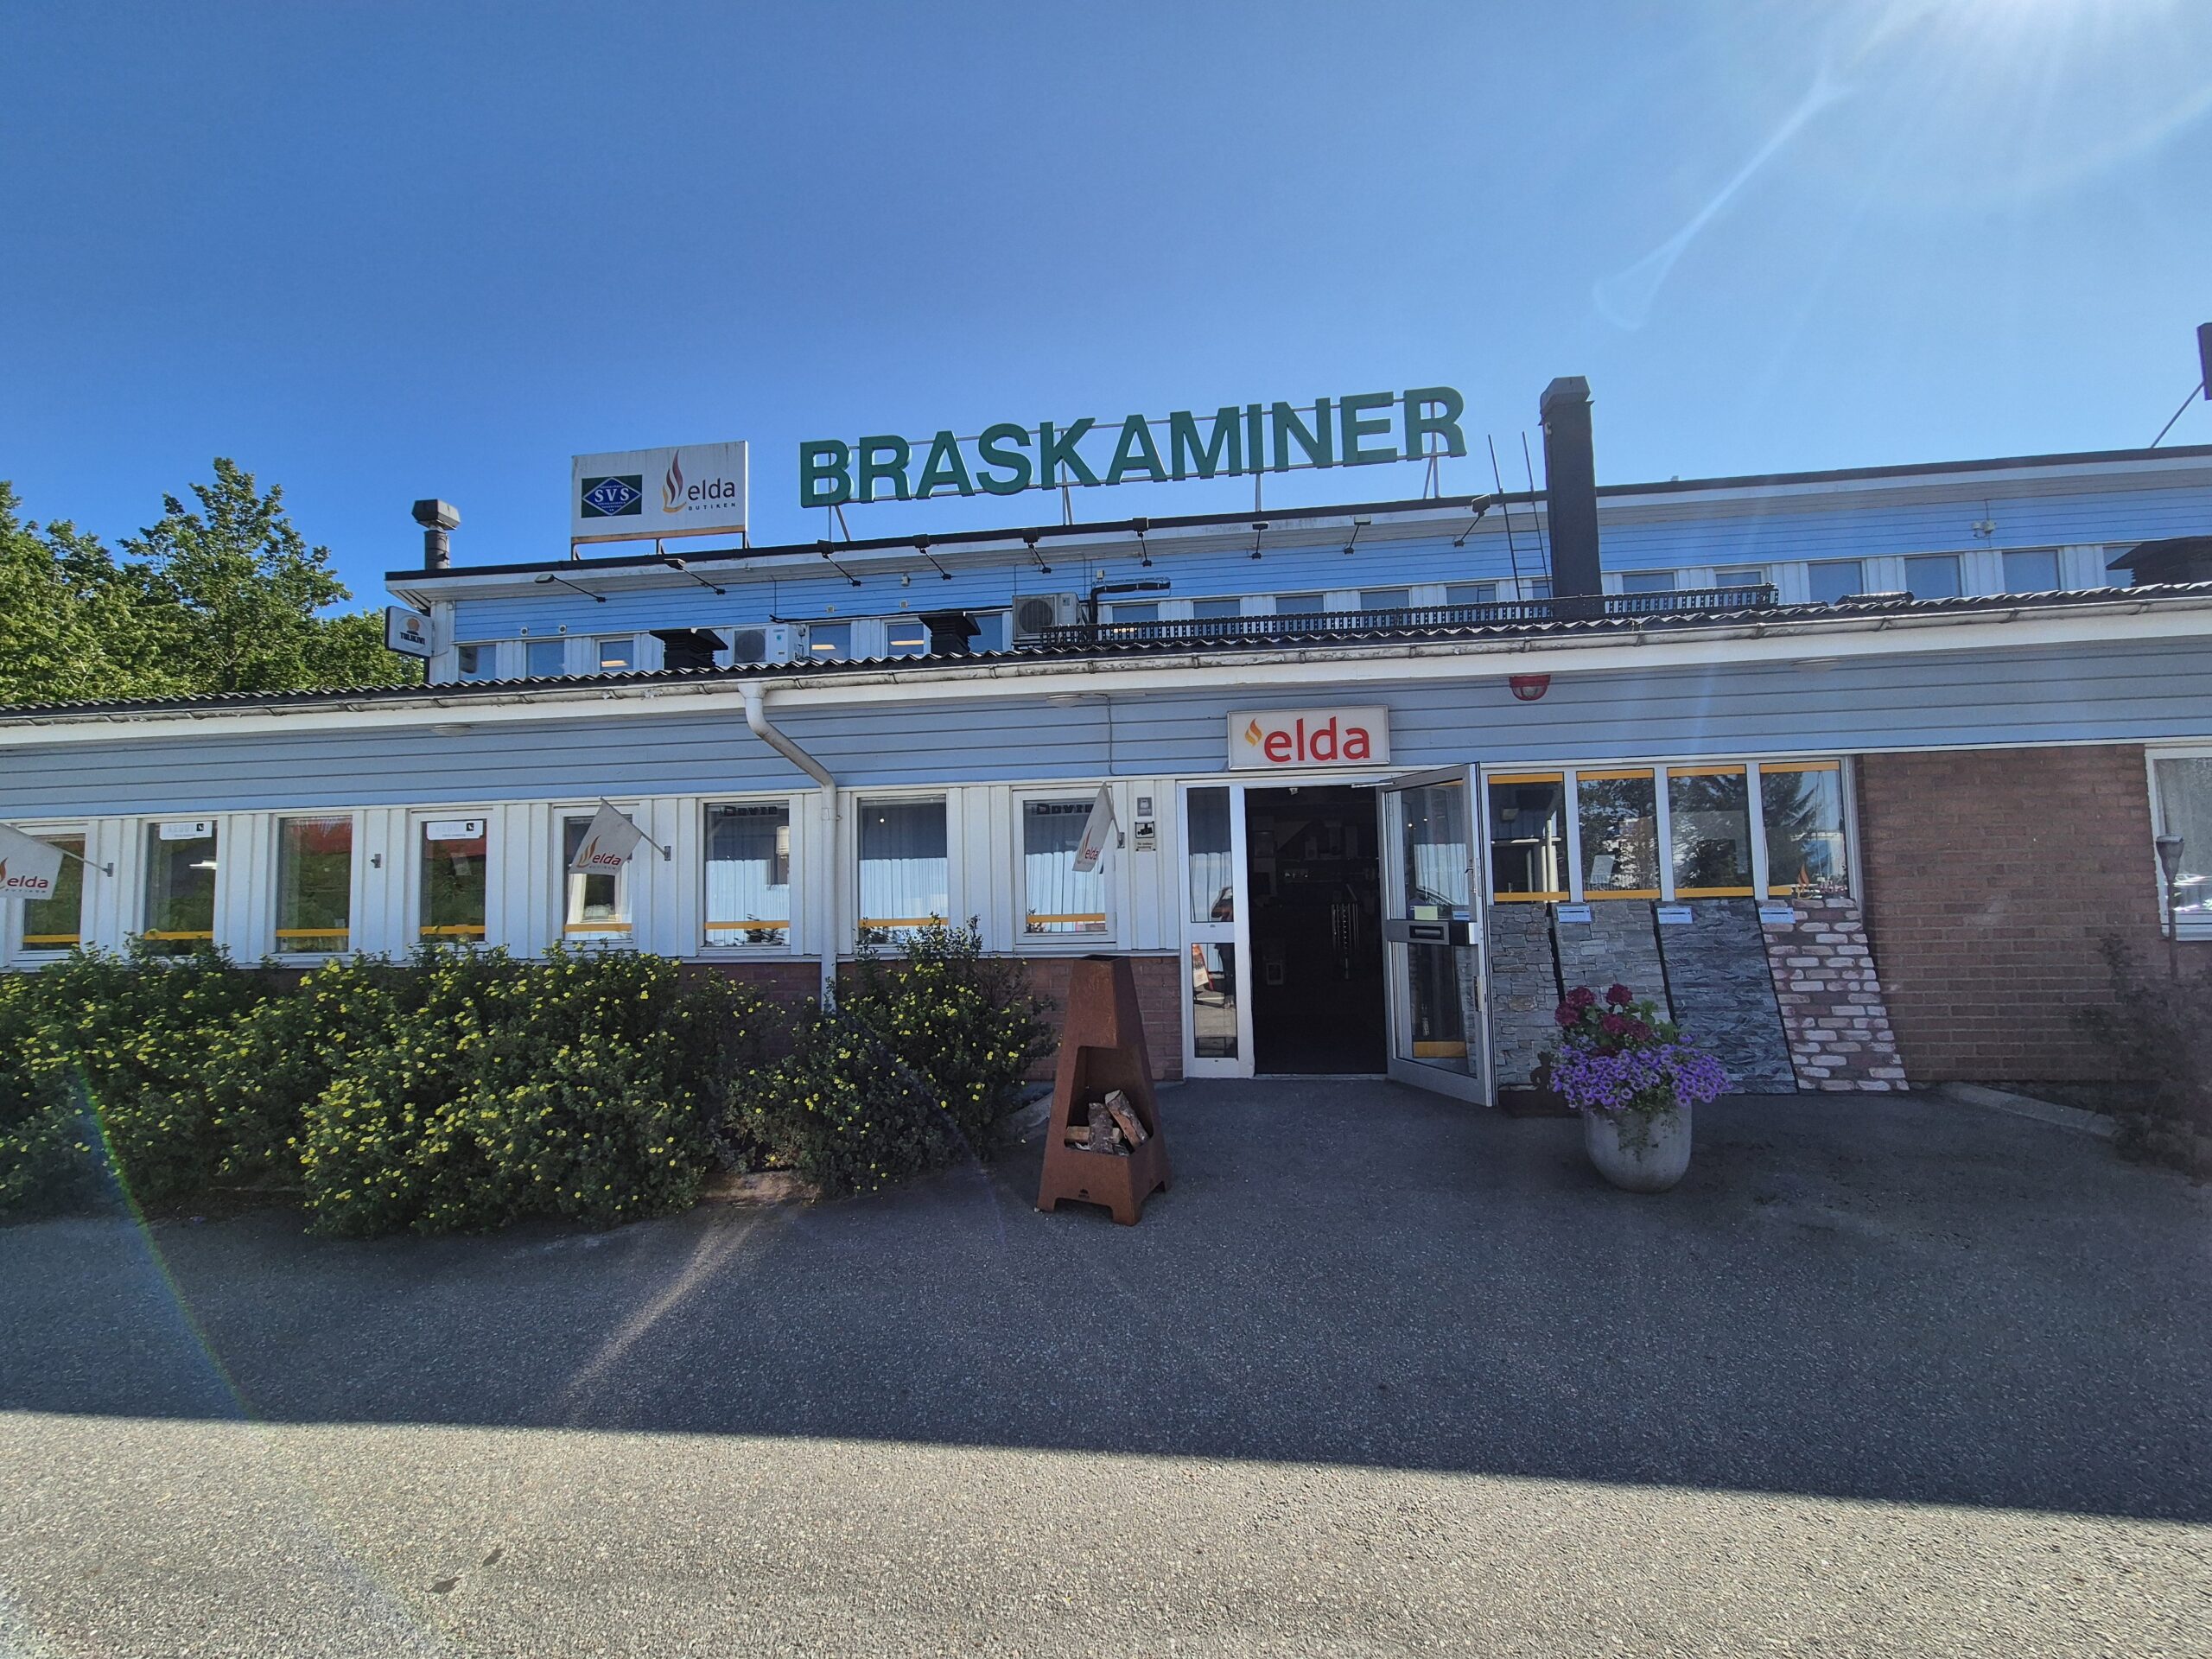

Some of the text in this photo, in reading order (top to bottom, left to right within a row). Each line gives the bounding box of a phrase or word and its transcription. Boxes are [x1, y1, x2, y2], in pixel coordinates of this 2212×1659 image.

[800, 386, 1467, 508] BRASKAMINER
[594, 488, 630, 503] SVS
[688, 477, 734, 501] elda
[1264, 716, 1370, 763] elda
[592, 853, 621, 866] elda
[7, 875, 48, 888] elda
